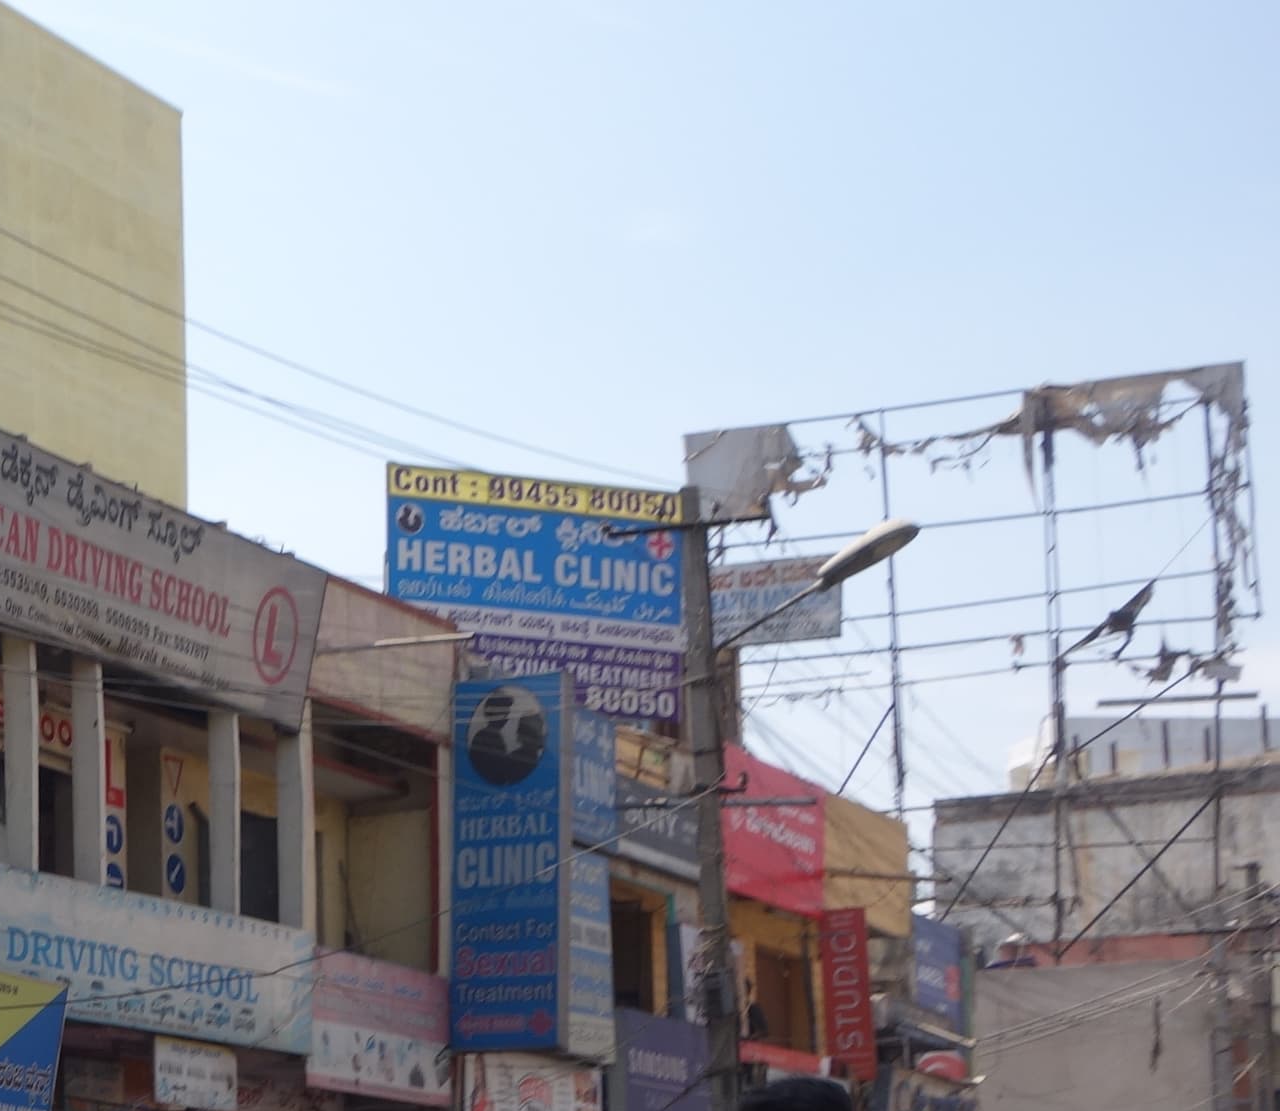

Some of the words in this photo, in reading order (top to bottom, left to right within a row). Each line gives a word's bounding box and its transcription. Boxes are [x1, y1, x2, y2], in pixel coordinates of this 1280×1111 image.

[394, 466, 460, 496] Cont
[488, 478, 578, 509] 99455
[46, 524, 143, 602] DRIVING
[148, 568, 232, 639] SCHOOL
[396, 537, 543, 584] HERBAL
[553, 552, 677, 597] CLINIC
[261, 604, 289, 668] L
[458, 813, 553, 842] HERBAL
[456, 842, 557, 890] CLINIC
[455, 916, 521, 944] Contact
[525, 916, 555, 938] For
[6, 922, 140, 982] DRIVING
[148, 951, 260, 1005] SCHOOL
[455, 943, 556, 980] Sexual
[456, 982, 554, 1003] Treatment
